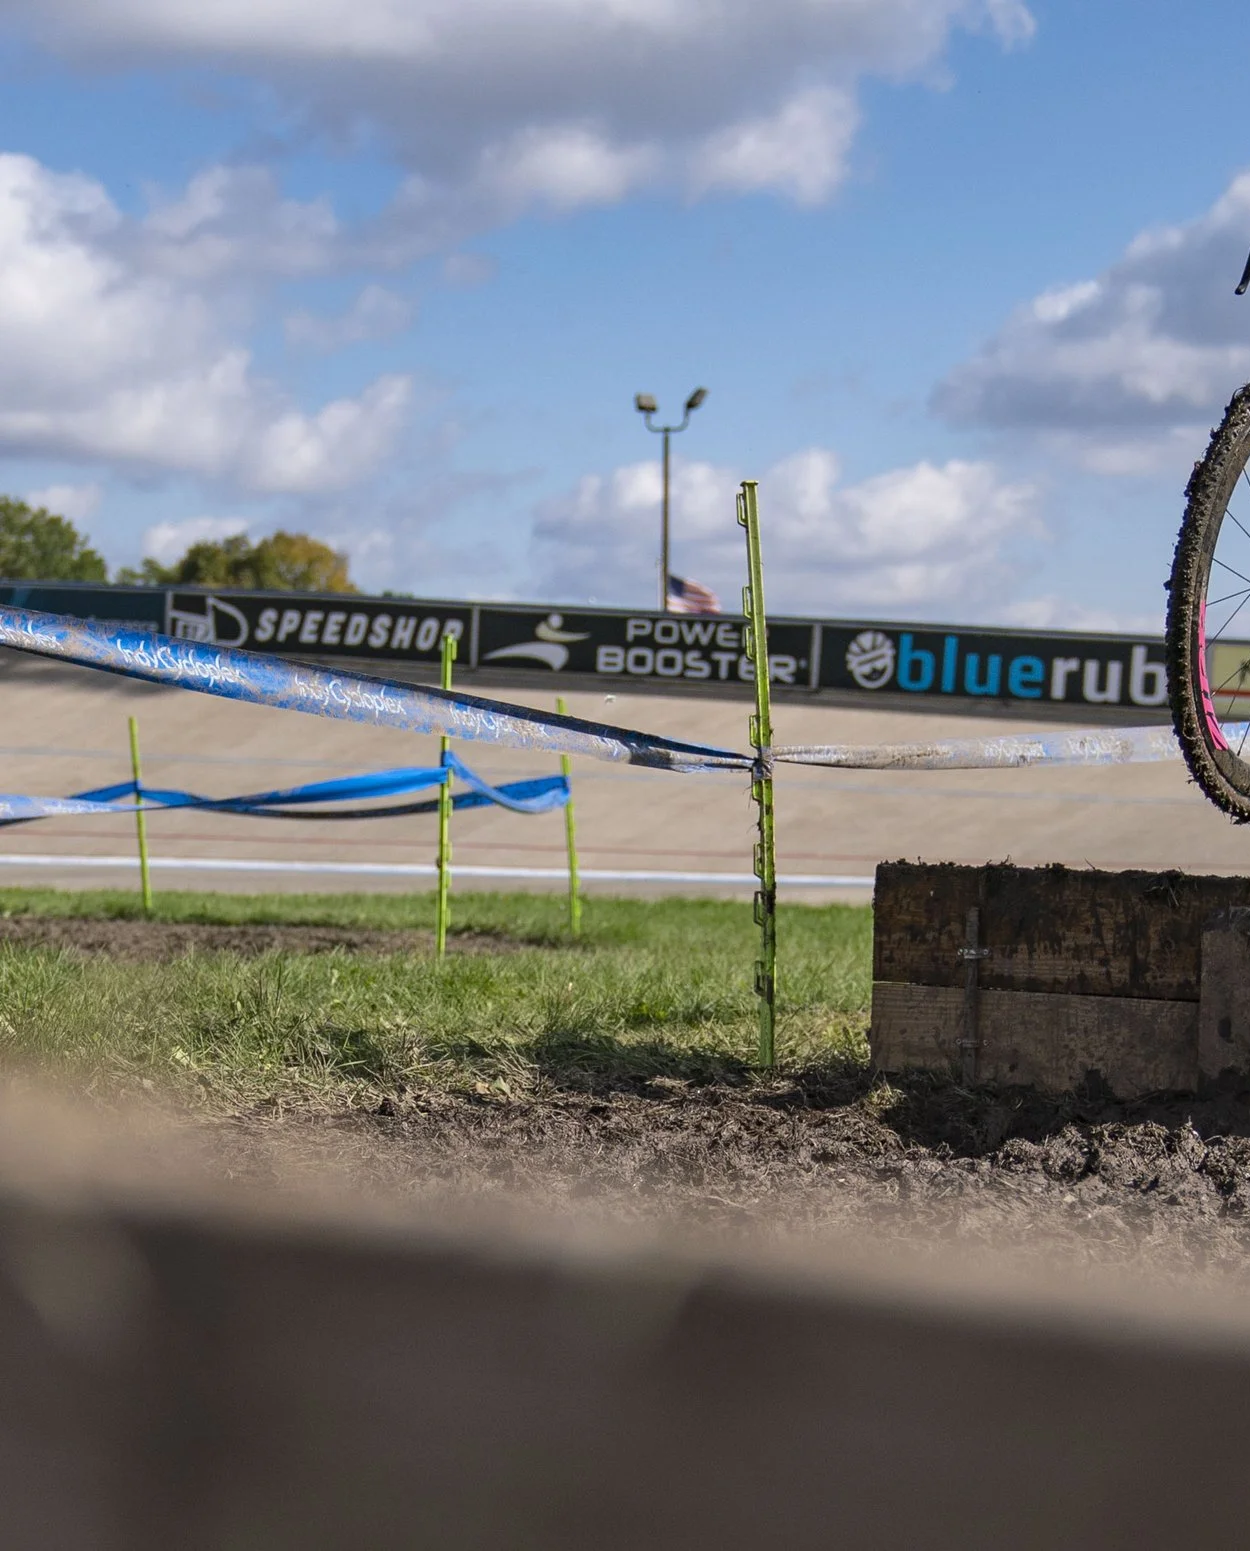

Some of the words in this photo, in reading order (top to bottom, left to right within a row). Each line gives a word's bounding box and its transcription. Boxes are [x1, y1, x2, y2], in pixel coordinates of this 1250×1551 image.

[254, 607, 464, 652] SPEEDSHOP
[625, 618, 769, 649] POWE
[596, 645, 797, 684] BOOSTER
